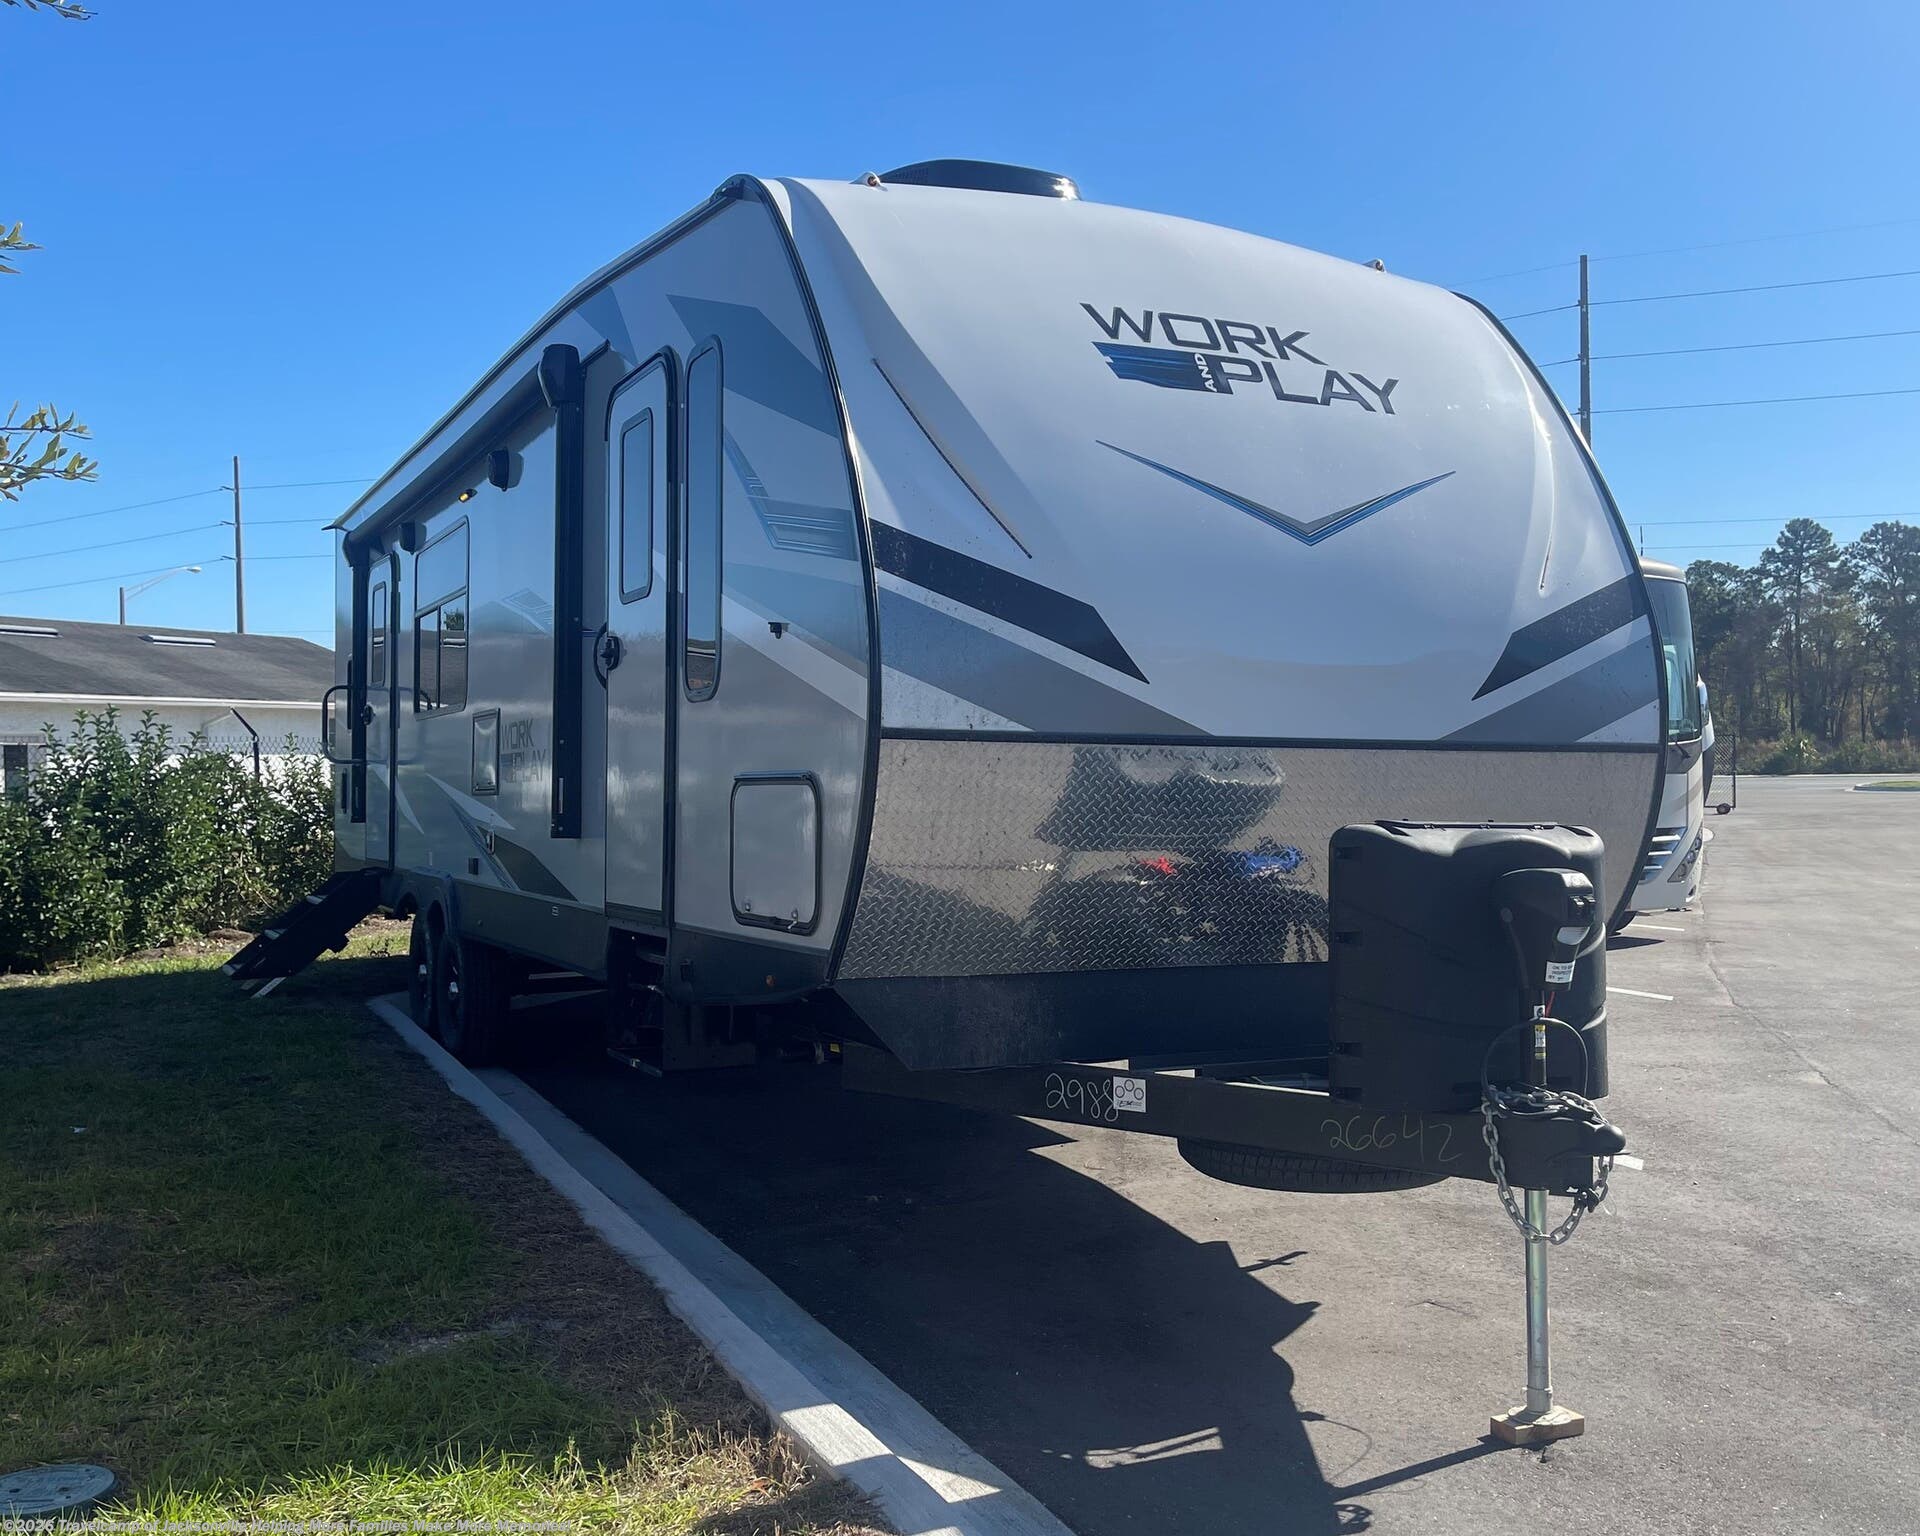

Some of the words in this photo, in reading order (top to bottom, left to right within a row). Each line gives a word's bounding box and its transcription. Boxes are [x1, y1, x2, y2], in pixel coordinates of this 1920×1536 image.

[1079, 302, 1329, 366] WORK
[1194, 353, 1218, 393] AND
[1211, 355, 1400, 415] PLAY
[501, 719, 535, 750] WORK
[1320, 1111, 1463, 1163] 26642
